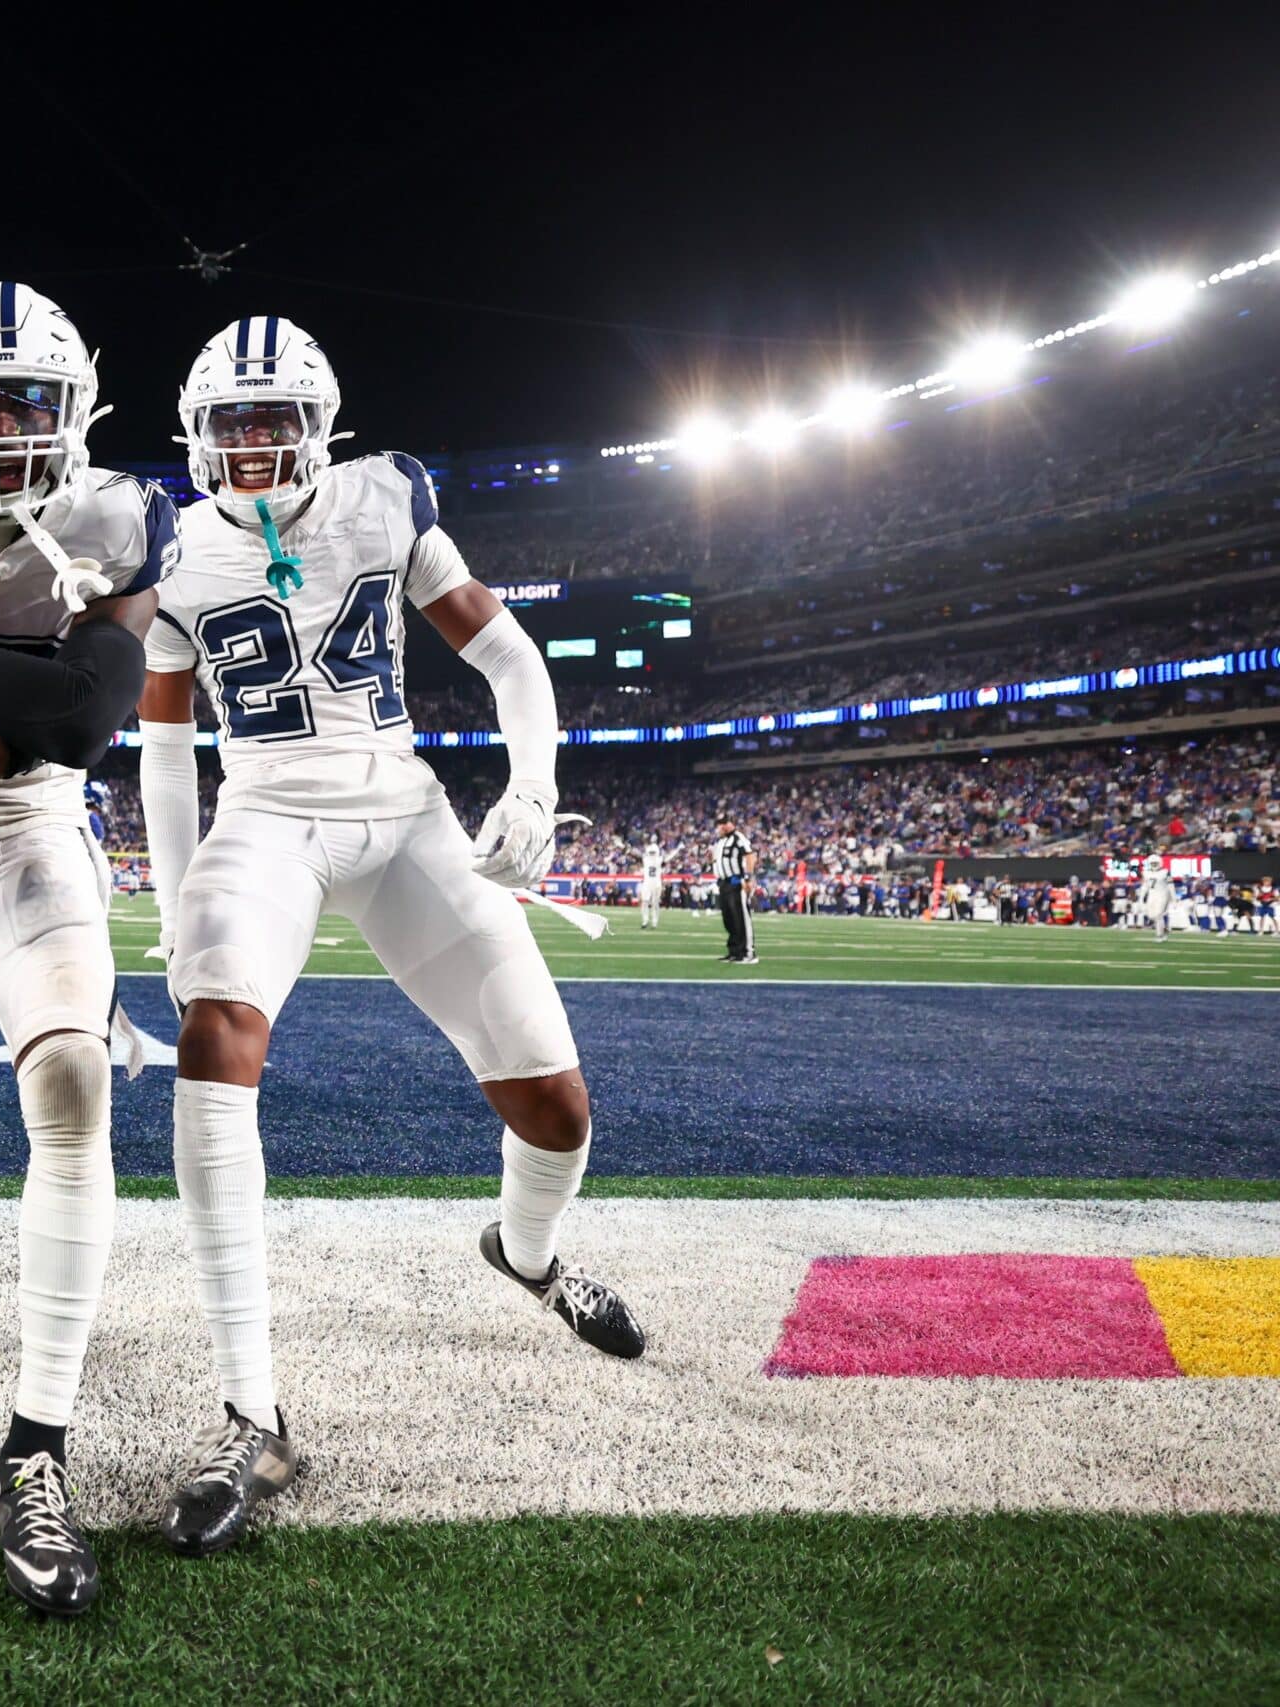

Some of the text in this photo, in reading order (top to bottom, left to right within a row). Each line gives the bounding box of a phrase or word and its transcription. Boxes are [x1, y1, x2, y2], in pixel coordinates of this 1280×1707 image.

[235, 378, 274, 387] COWBOYS
[508, 583, 561, 600] LIGHT
[194, 569, 409, 743] 24
